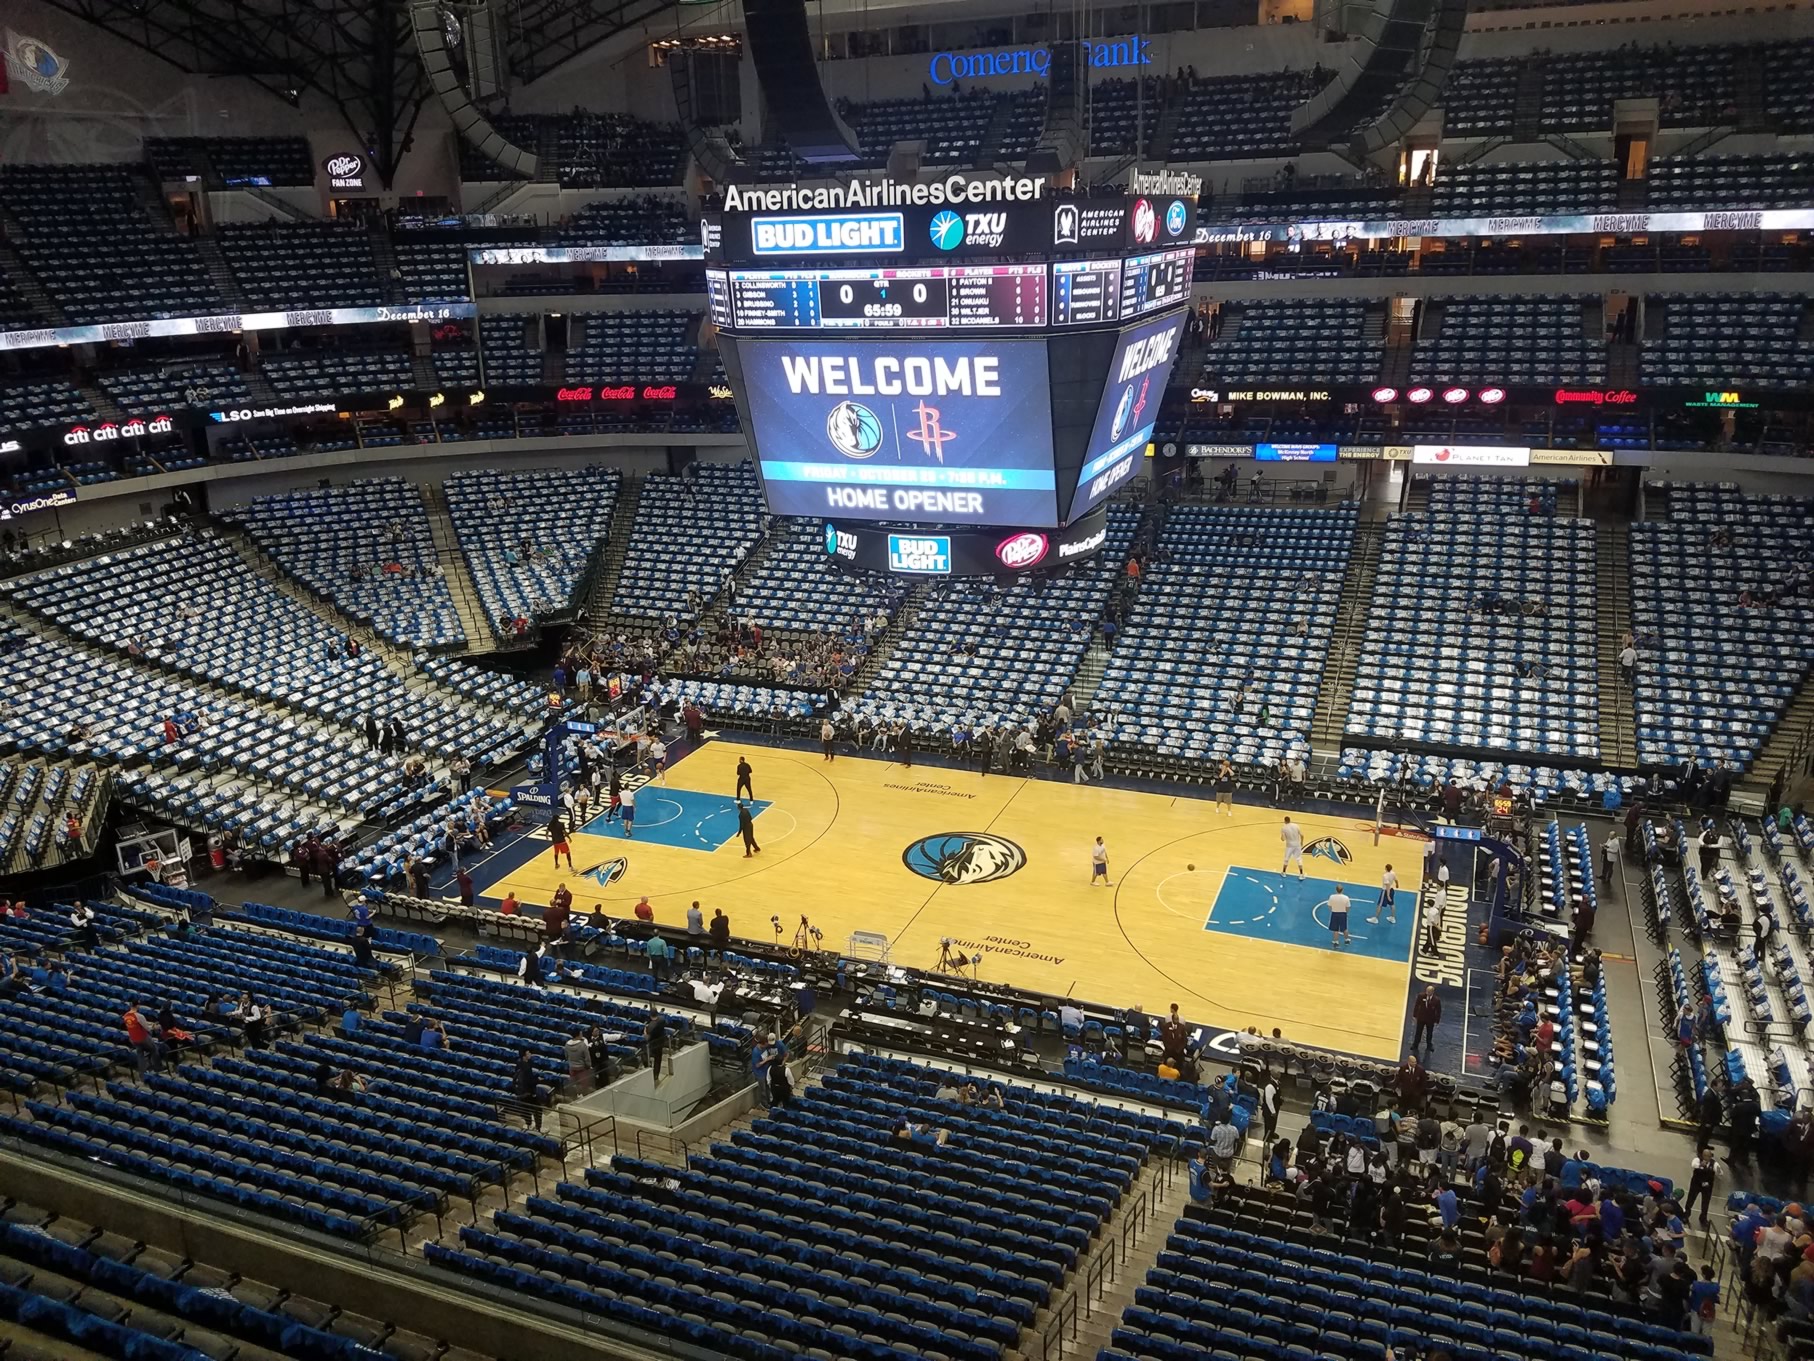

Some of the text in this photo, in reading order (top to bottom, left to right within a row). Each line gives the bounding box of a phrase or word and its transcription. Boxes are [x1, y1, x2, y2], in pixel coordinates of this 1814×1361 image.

[328, 159, 357, 175] Pepper
[338, 157, 350, 166] Dr
[1081, 209, 1124, 218] AMERICAN
[1704, 212, 1763, 230] MERCYME
[966, 213, 1006, 235] TXU
[1081, 218, 1120, 227] AIRLINES
[1387, 220, 1439, 237] MERCYME
[1488, 217, 1542, 234] MERCYME
[1594, 214, 1648, 232] MERCYME
[758, 220, 896, 248] BUD LIGHT
[966, 232, 1004, 247] energy
[1196, 226, 1272, 243] December 16
[566, 247, 608, 262] MERCYME
[840, 284, 853, 304] 0
[880, 289, 886, 298] 1
[913, 283, 927, 303] 0
[377, 305, 450, 320] December 16
[864, 304, 902, 316] 65:59
[195, 316, 243, 333] MERCYME
[286, 311, 333, 326] MERCYME
[102, 322, 150, 340] MERCYME
[4, 330, 56, 348] MERCYME
[1118, 327, 1177, 384] WELCOME
[781, 356, 1001, 396] WELCOME
[558, 387, 593, 400] Coca-Cola
[602, 387, 636, 400] Coca-Cola
[643, 386, 677, 399] Coca-Cola
[1228, 392, 1332, 401] MIKE BOWMAN, INC.
[1556, 390, 1636, 404] Community Coffee
[1706, 392, 1740, 402] WM
[221, 410, 252, 422] LSO
[94, 427, 118, 441] citi
[121, 423, 144, 437] citi
[149, 420, 171, 434] citi
[64, 429, 89, 444] citi
[12, 499, 54, 514] CyrusOne
[54, 498, 77, 506] Centers
[826, 487, 984, 514] HOME OPENER
[836, 530, 857, 550] TXU
[899, 539, 938, 554] BUD
[836, 547, 856, 560] energy
[893, 553, 946, 570] LIGHT
[915, 782, 952, 790] Center
[517, 791, 551, 805] SPALDING
[982, 936, 1031, 949] Center
[953, 938, 1065, 965] AmericanAirline
